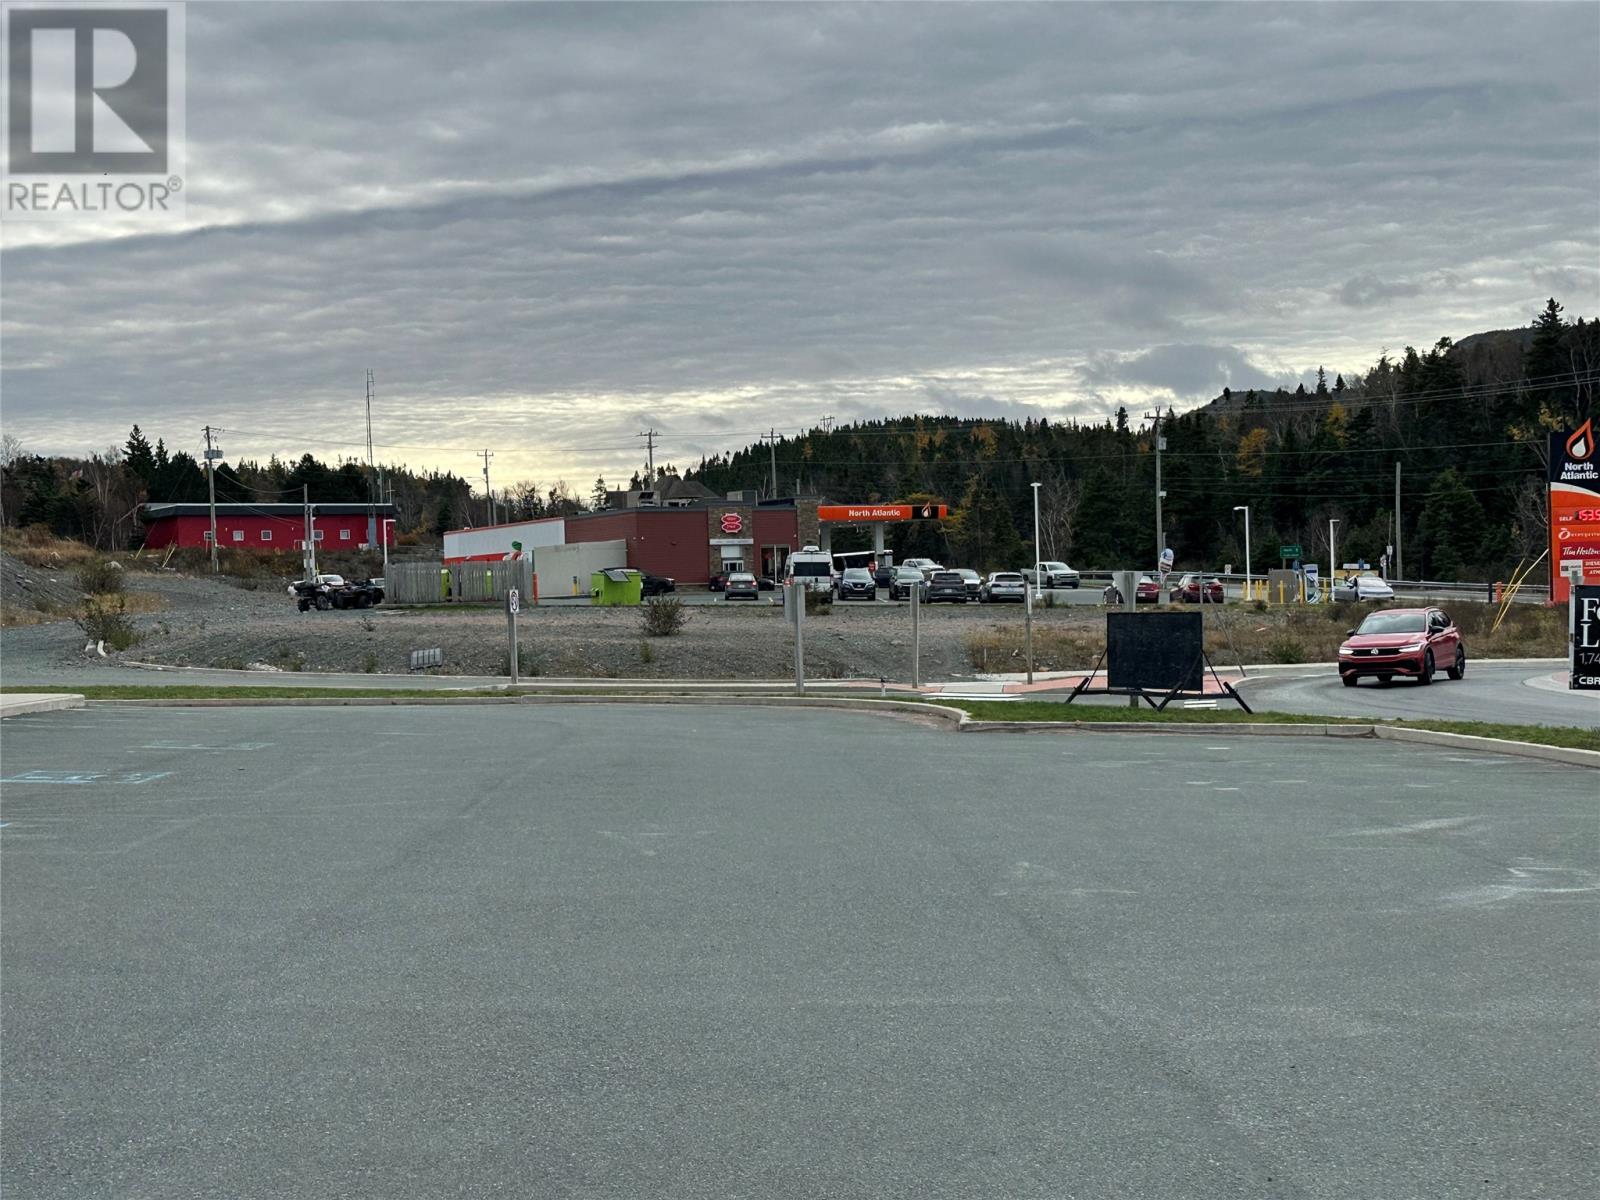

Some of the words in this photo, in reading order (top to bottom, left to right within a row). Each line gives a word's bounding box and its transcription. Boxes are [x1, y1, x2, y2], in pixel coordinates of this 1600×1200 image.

[1564, 462, 1594, 471] North
[1560, 471, 1599, 480] Atlantic
[848, 509, 870, 517] North
[871, 509, 901, 517] Atlantic
[1562, 546, 1576, 556] Tim
[1576, 546, 1600, 556] Horton
